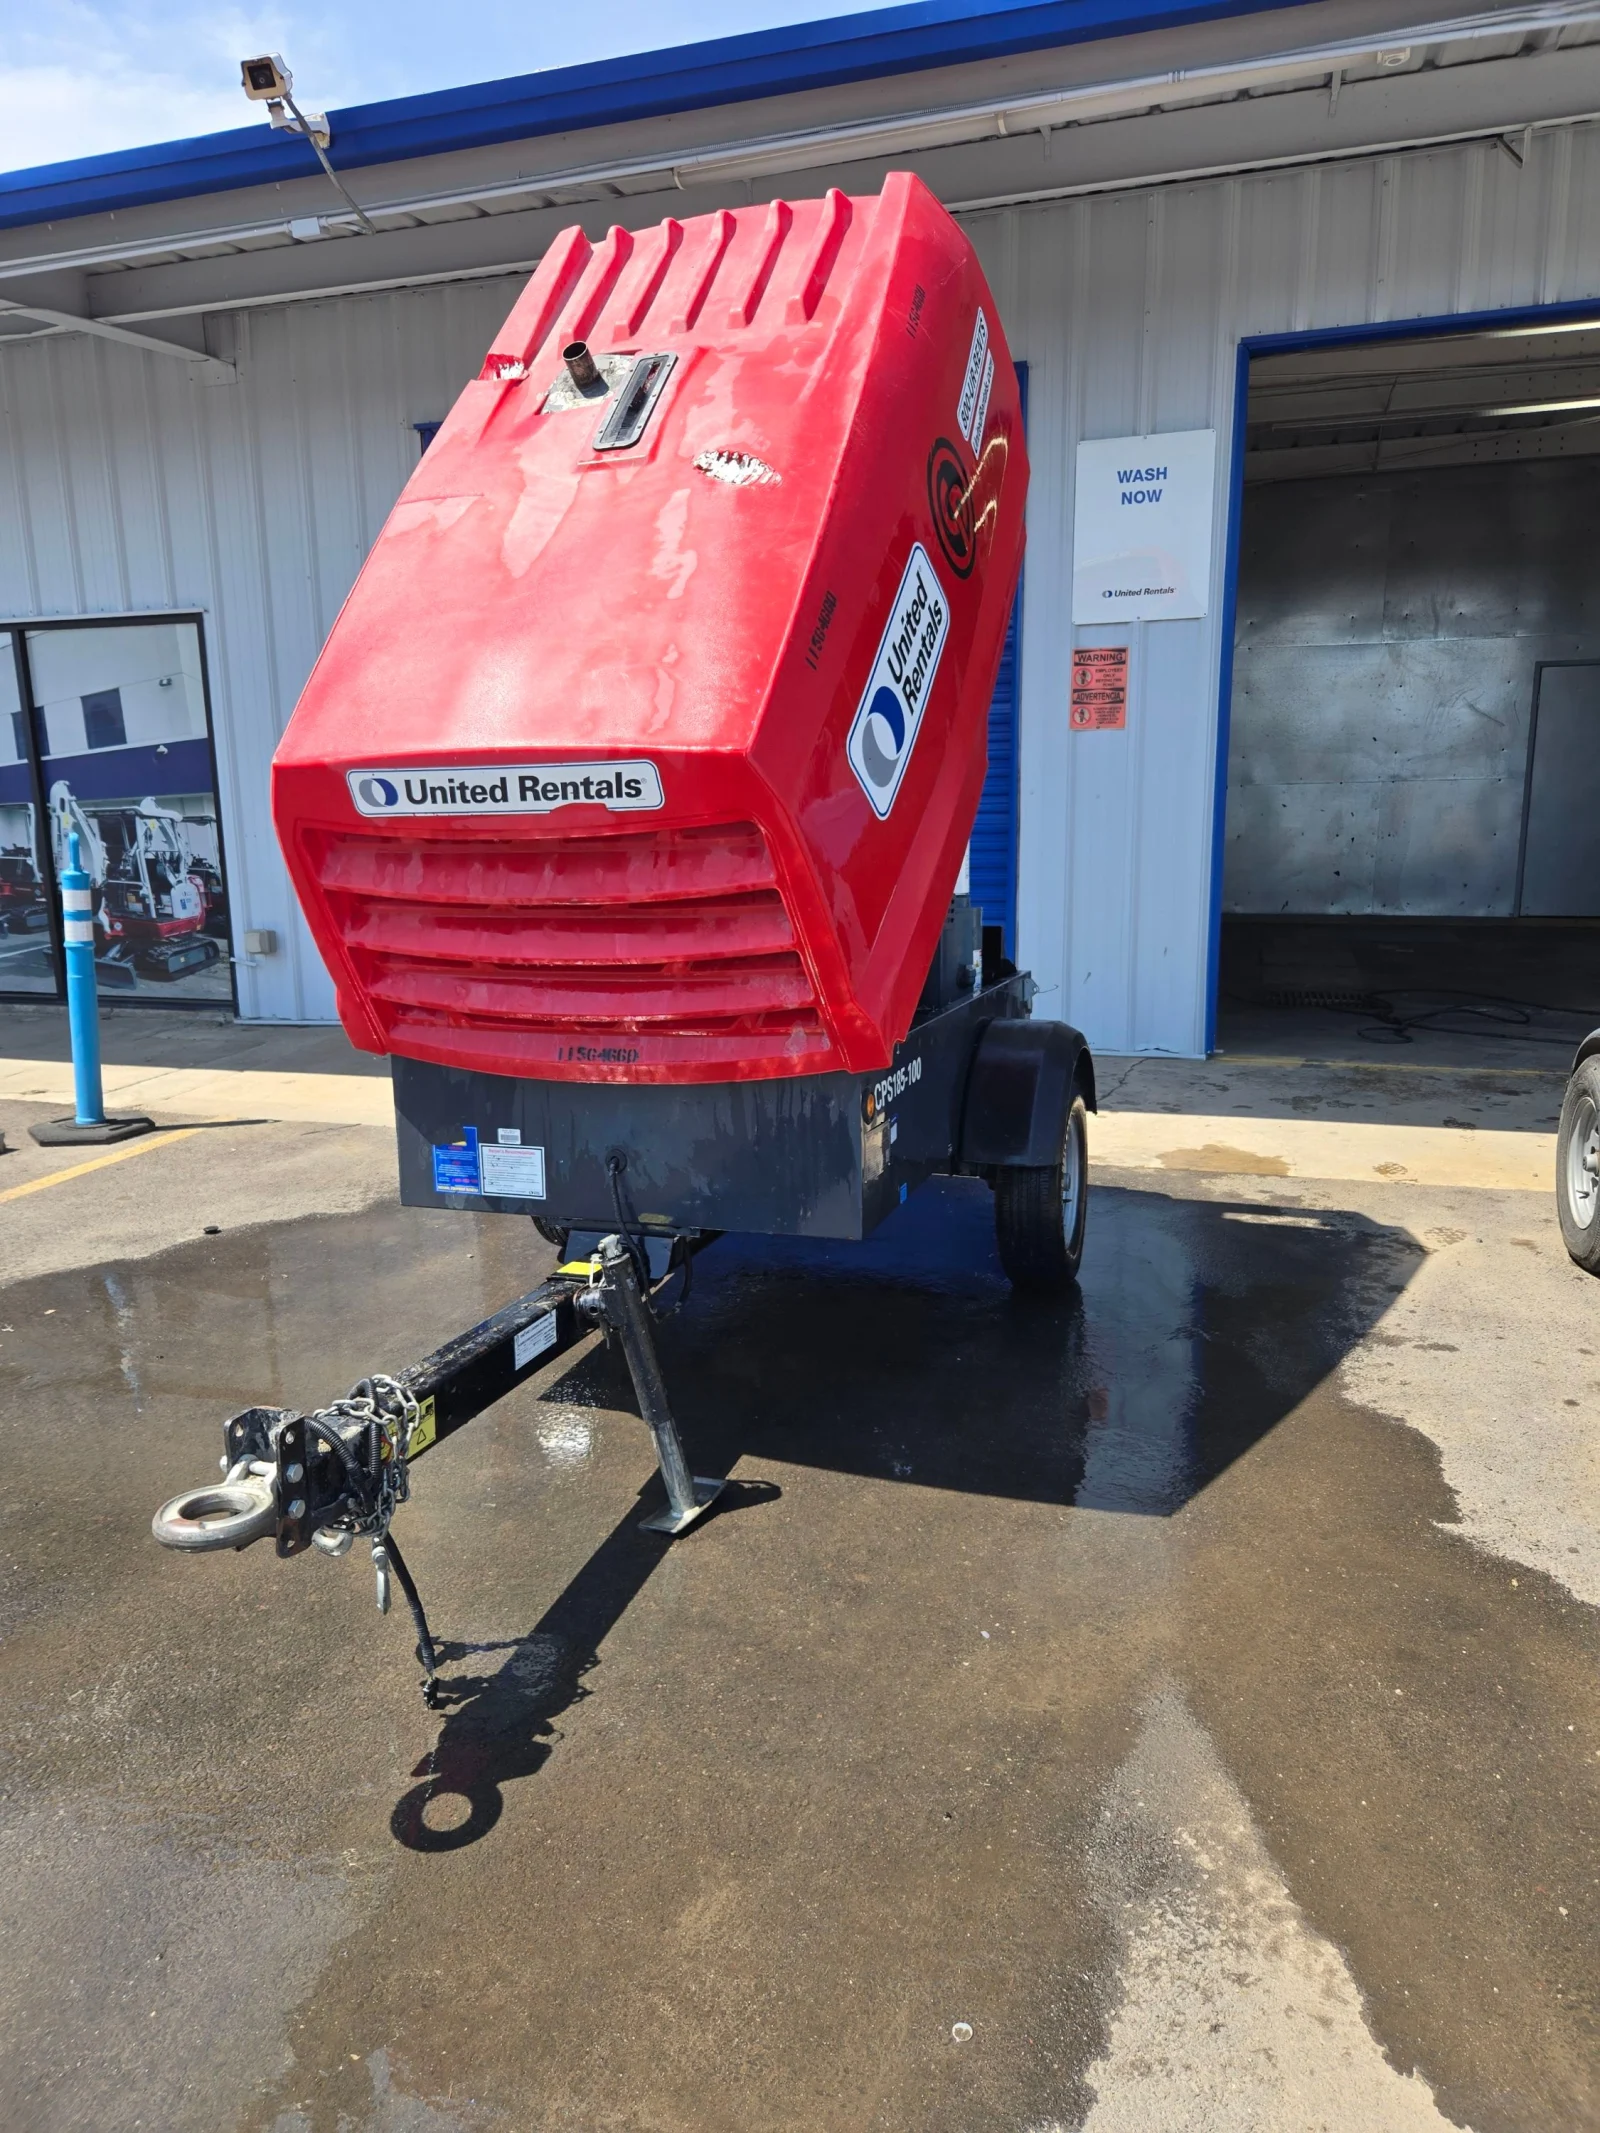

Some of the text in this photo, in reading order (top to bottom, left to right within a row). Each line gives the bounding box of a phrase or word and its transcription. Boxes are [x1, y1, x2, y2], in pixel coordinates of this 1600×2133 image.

[1117, 466, 1168, 484] WASH
[1121, 489, 1163, 505] NOW
[1114, 586, 1175, 598] United Rentals
[887, 571, 928, 684] United
[902, 599, 943, 716] Rentals
[1077, 653, 1123, 663] WARNING
[1076, 692, 1121, 702] ADVERTENCIA
[404, 772, 643, 805] United Rentals
[874, 1057, 922, 1110] CPS185-100
